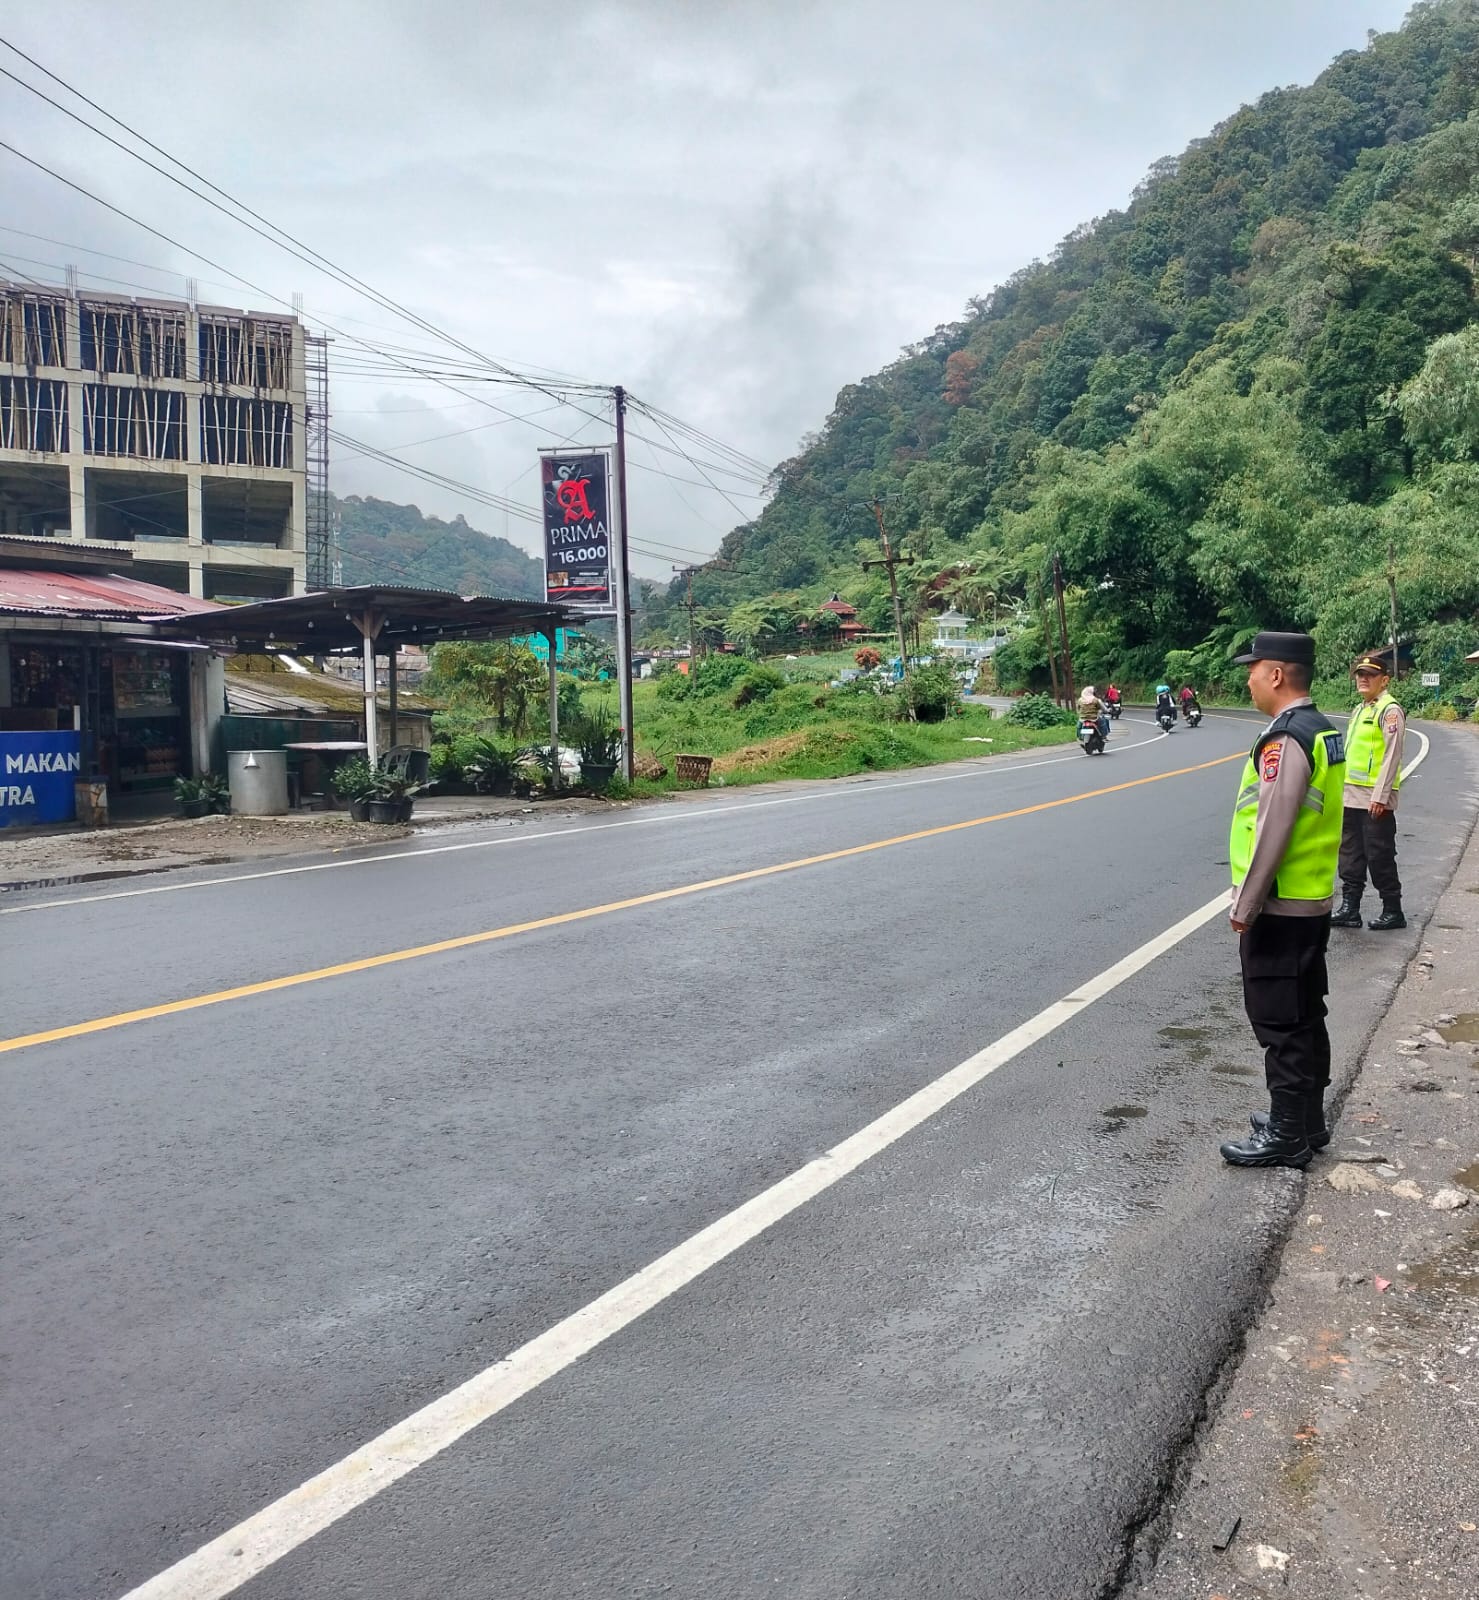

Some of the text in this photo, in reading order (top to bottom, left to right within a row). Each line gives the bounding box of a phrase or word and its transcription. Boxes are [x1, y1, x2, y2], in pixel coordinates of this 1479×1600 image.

[550, 521, 608, 545] PRIMA
[559, 545, 607, 564] 16.000
[6, 752, 80, 774] MAKAN
